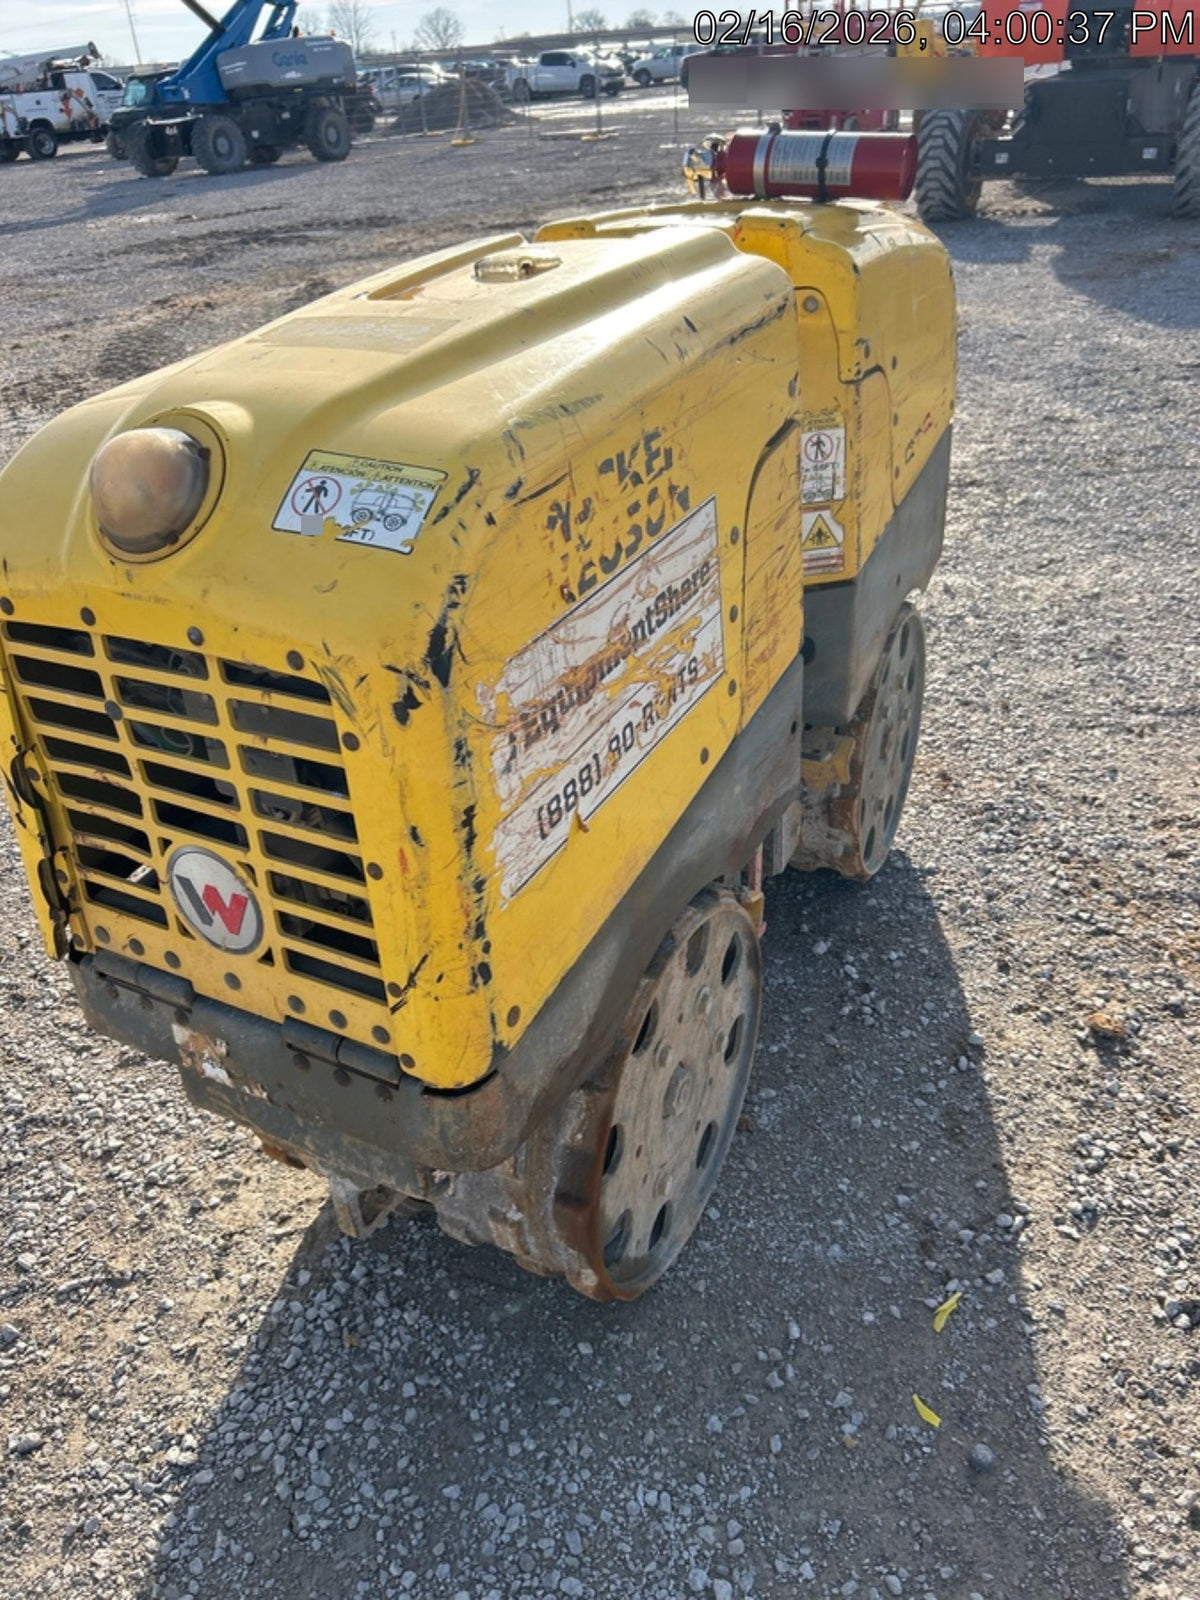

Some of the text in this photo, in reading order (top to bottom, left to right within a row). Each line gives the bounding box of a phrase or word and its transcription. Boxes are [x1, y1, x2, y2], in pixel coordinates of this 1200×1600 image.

[360, 461, 404, 473] CAUTION
[384, 475, 436, 490] ATTENTION
[537, 753, 602, 840] (888)
